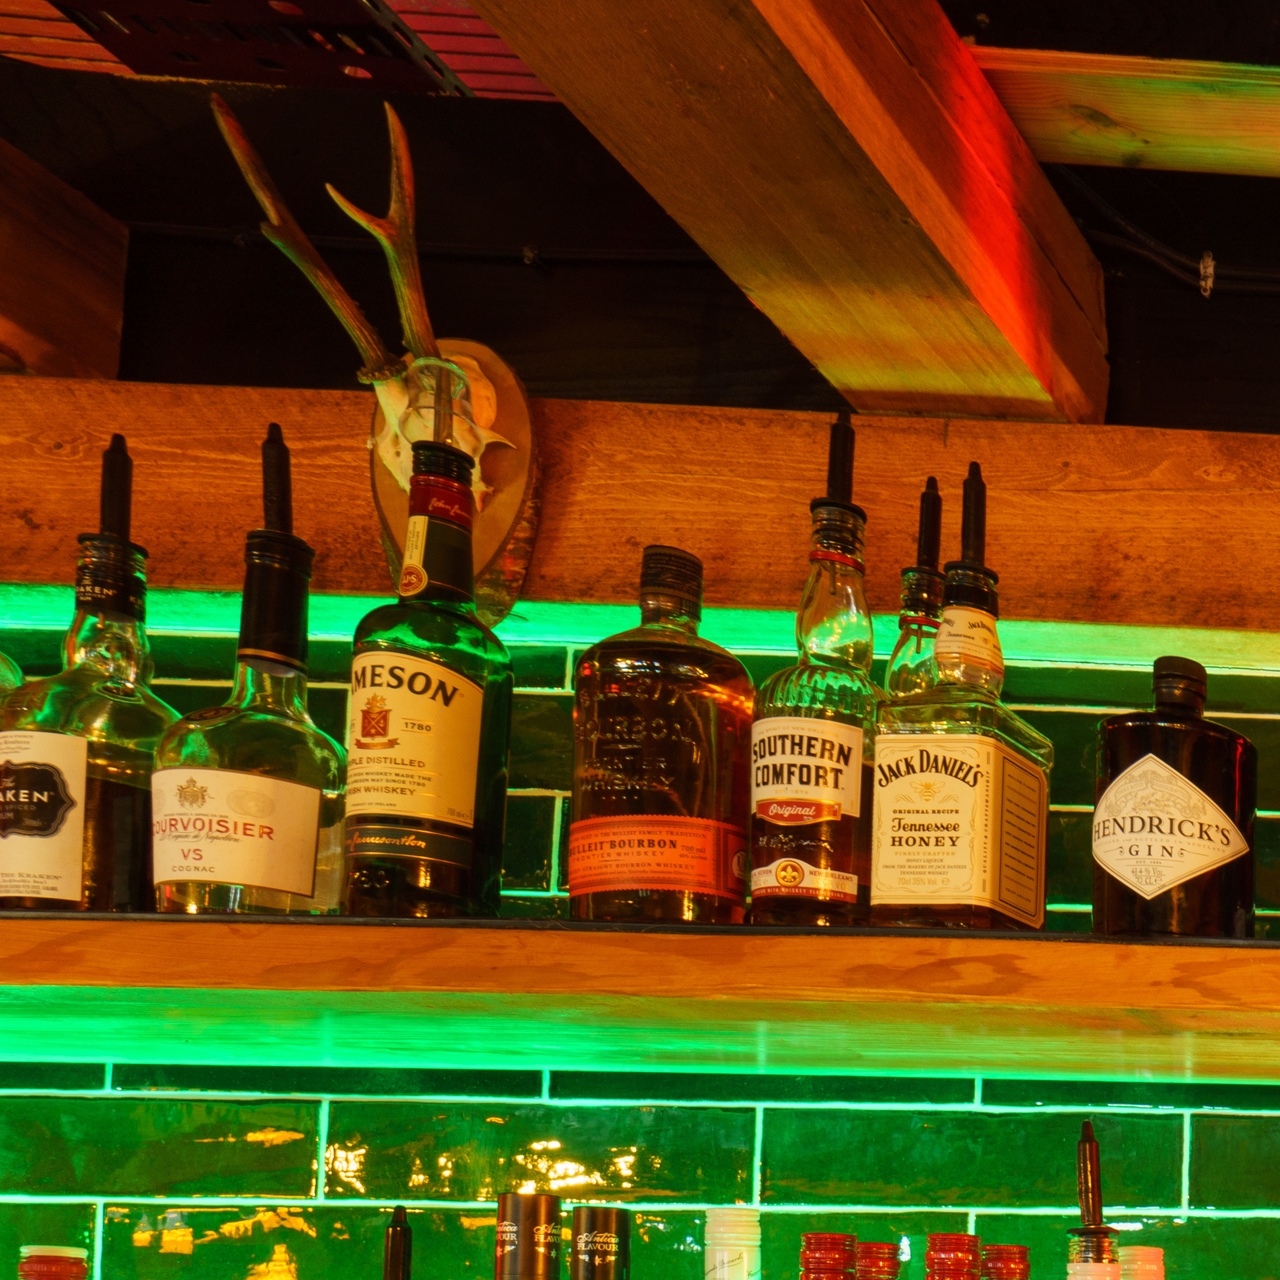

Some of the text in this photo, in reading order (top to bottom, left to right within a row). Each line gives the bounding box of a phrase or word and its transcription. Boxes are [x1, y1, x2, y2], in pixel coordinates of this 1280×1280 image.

[404, 722, 432, 732] 1780
[753, 734, 853, 767] SOUTHERN
[877, 748, 985, 788] JACK DANIEL'S
[755, 763, 843, 790] COMFORT
[769, 803, 816, 818] Original
[891, 817, 961, 833] Tennessee
[1093, 815, 1231, 848] HENDRICK'S
[609, 839, 677, 850] BOURBON
[890, 836, 961, 847] HONEY
[181, 848, 203, 861] VS
[616, 850, 665, 858] WHISKEY
[1129, 844, 1174, 858] GIN
[172, 864, 216, 873] COGNAC
[576, 1240, 620, 1253] FLAVOUR
